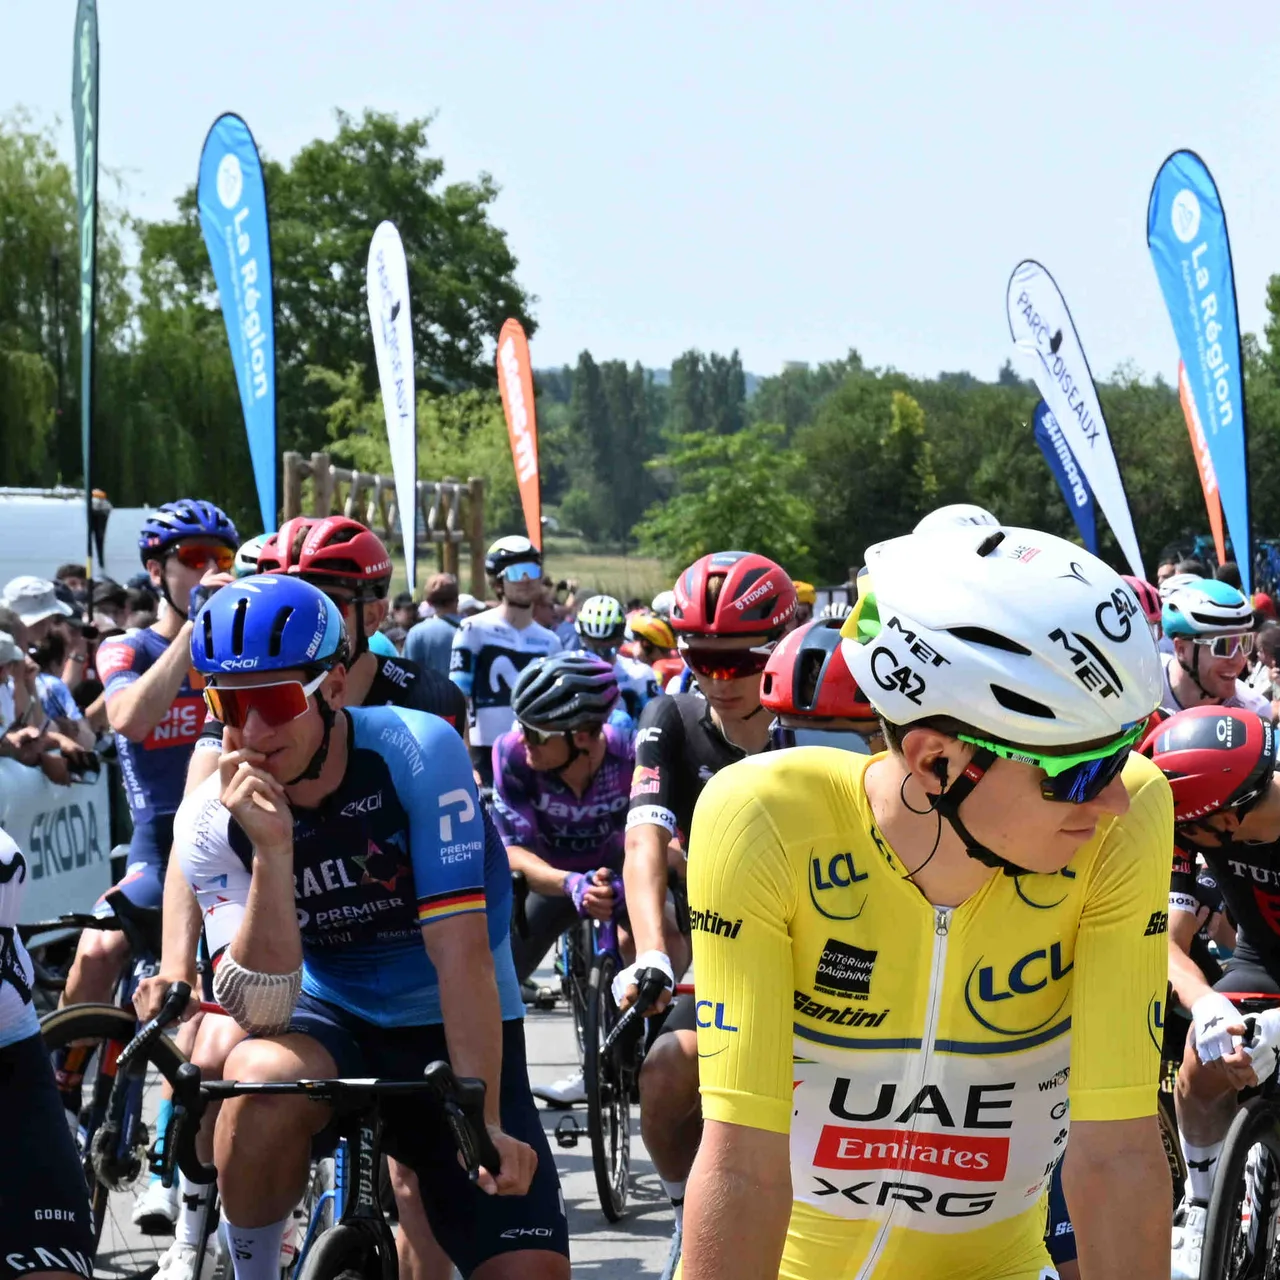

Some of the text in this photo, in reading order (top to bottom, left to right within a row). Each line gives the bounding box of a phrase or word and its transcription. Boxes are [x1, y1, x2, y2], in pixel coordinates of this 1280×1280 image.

[1017, 291, 1051, 346] PARC
[1192, 242, 1210, 291] La
[1201, 292, 1234, 427] Région
[1052, 354, 1101, 449] OISEAUX
[1041, 411, 1088, 508] SHIMANO
[744, 584, 769, 605] TUDOR
[1095, 588, 1138, 643] G42
[887, 616, 951, 667] MET
[1048, 628, 1121, 699] MET
[870, 646, 926, 706] G42
[530, 796, 629, 822] Jayco
[440, 852, 472, 865] TECH
[813, 852, 869, 890] LCL
[316, 898, 405, 926] PREMIER
[979, 940, 1074, 1002] LCL
[828, 1076, 1016, 1129] UAE
[359, 1127, 374, 1206] FACTOR
[836, 1137, 990, 1171] Emirates
[34, 1208, 76, 1223] GOBIK
[812, 1176, 998, 1217] XRG
